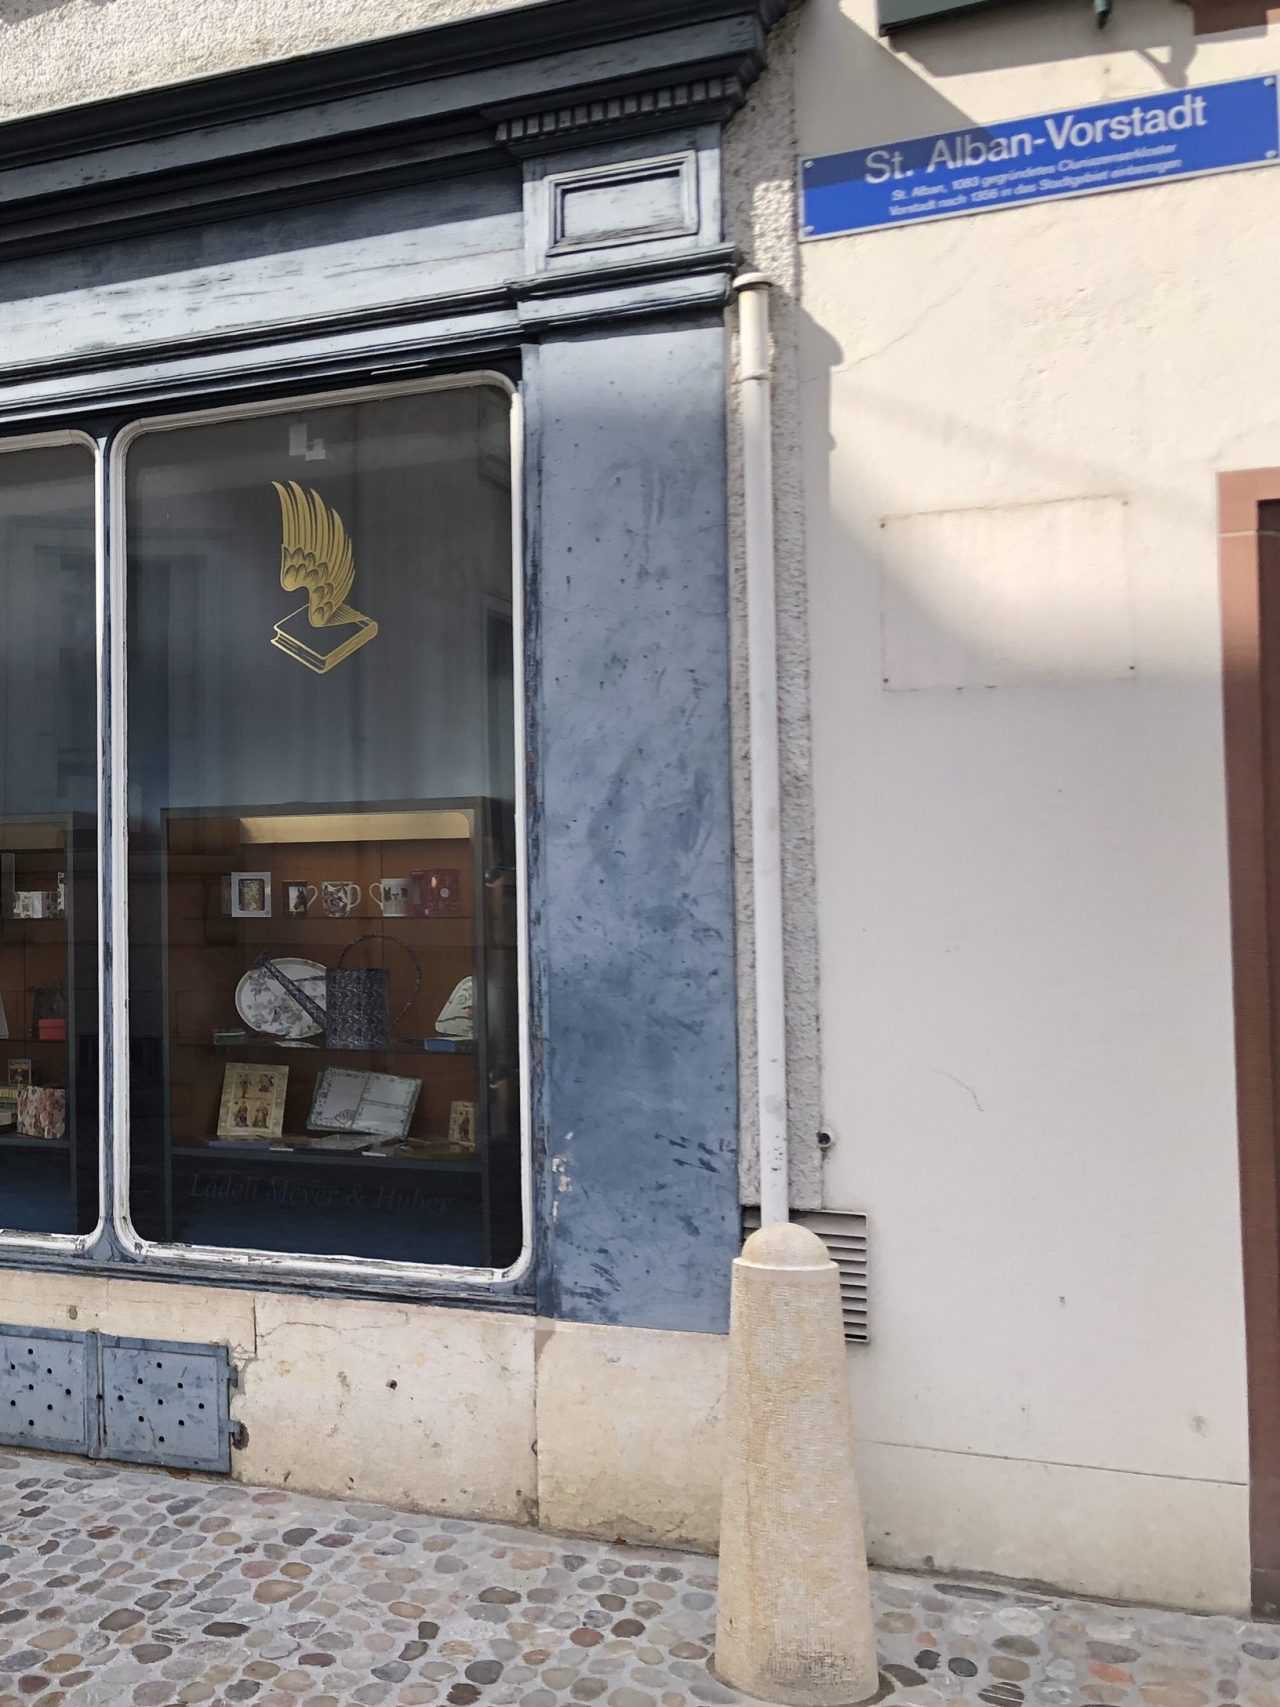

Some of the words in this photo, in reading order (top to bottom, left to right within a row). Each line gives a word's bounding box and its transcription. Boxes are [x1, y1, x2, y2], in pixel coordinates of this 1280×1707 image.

[864, 150, 913, 183] St.
[926, 94, 1208, 173] Alban-Vorstadt
[889, 200, 937, 216] Vorstadt
[938, 194, 968, 207] nach
[1014, 183, 1037, 195] das
[1039, 170, 1109, 191] Stadtgebiet
[892, 189, 907, 201] St.
[952, 176, 980, 190] 1083
[346, 1183, 366, 1208] &
[375, 1184, 453, 1214] Huber
